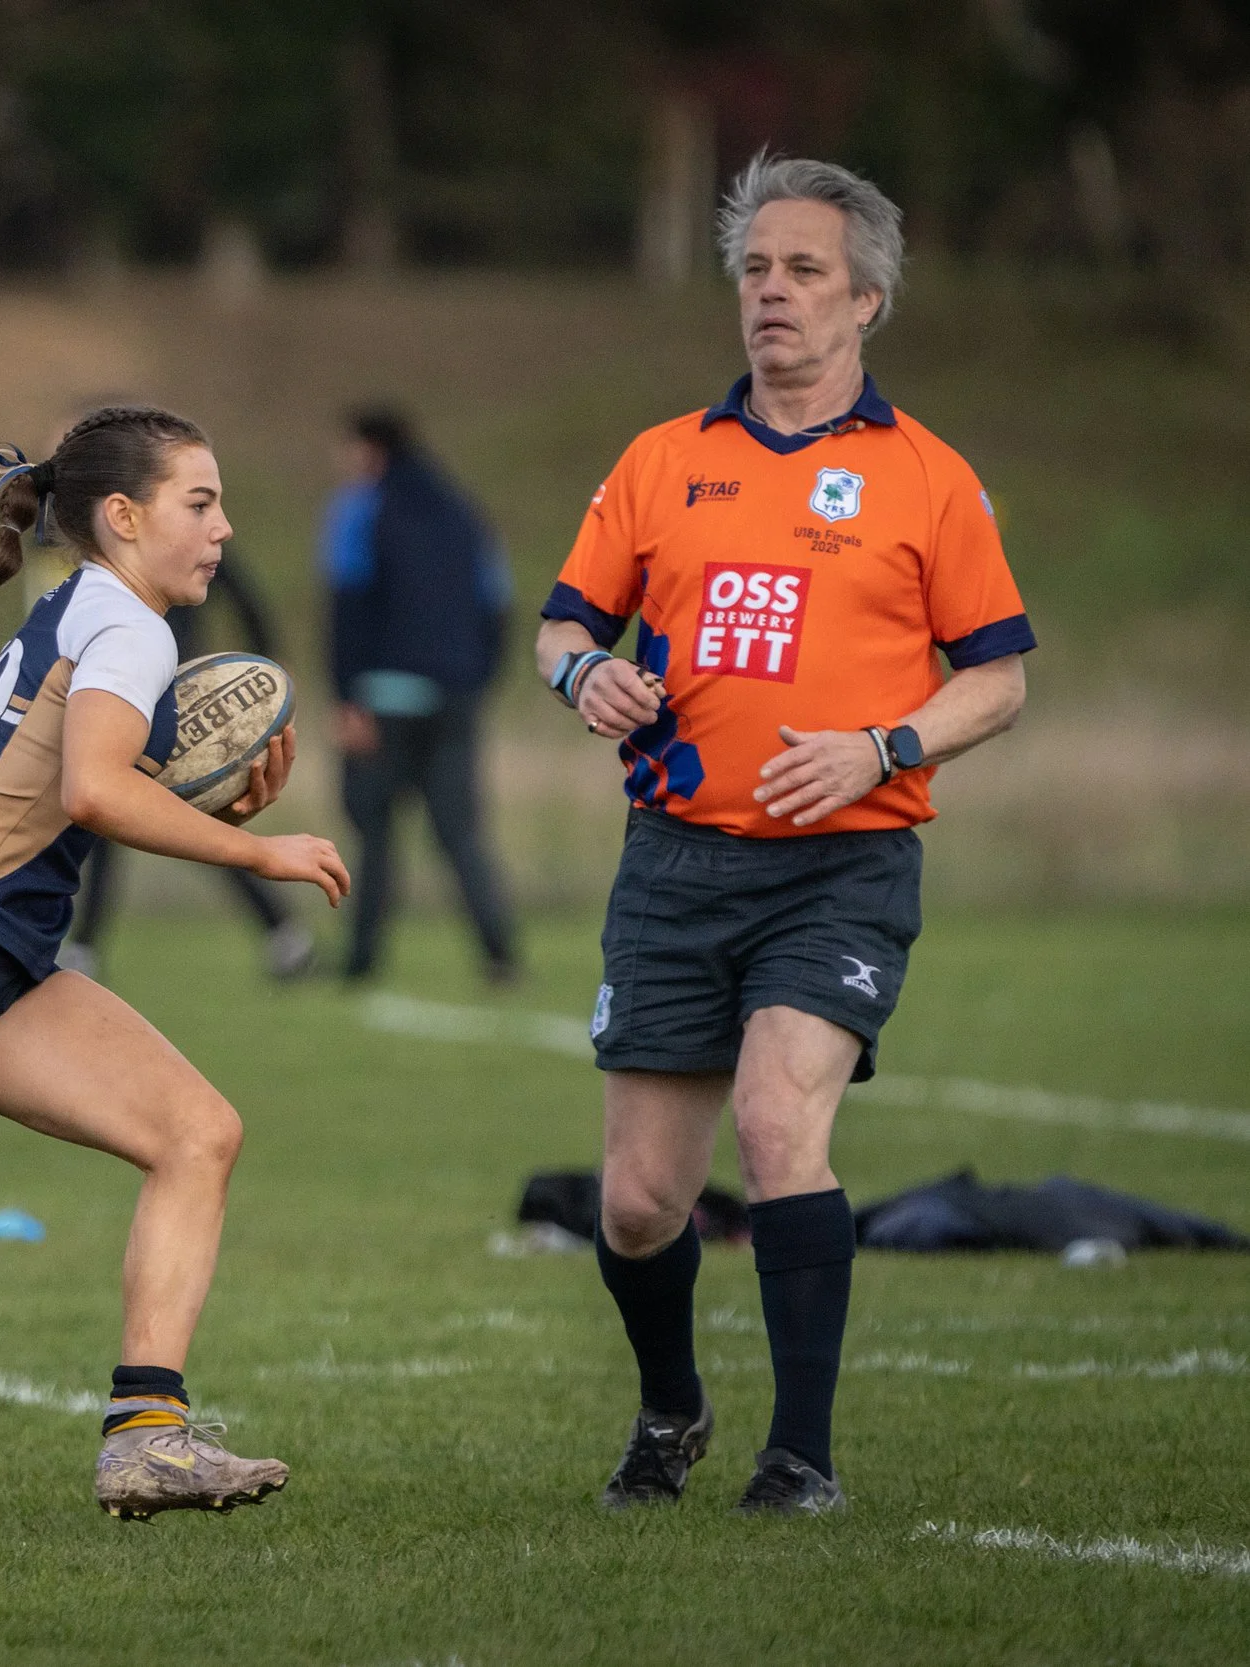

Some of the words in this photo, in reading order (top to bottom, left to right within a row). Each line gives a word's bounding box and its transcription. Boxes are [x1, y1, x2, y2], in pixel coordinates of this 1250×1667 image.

[696, 481, 741, 497] STAG
[824, 503, 846, 514] YRS
[794, 527, 821, 539] U18s
[825, 529, 862, 547] Finals
[810, 540, 840, 554] 2025
[710, 571, 801, 613] OSS
[704, 610, 795, 630] BREWERY
[697, 626, 793, 673] ETT
